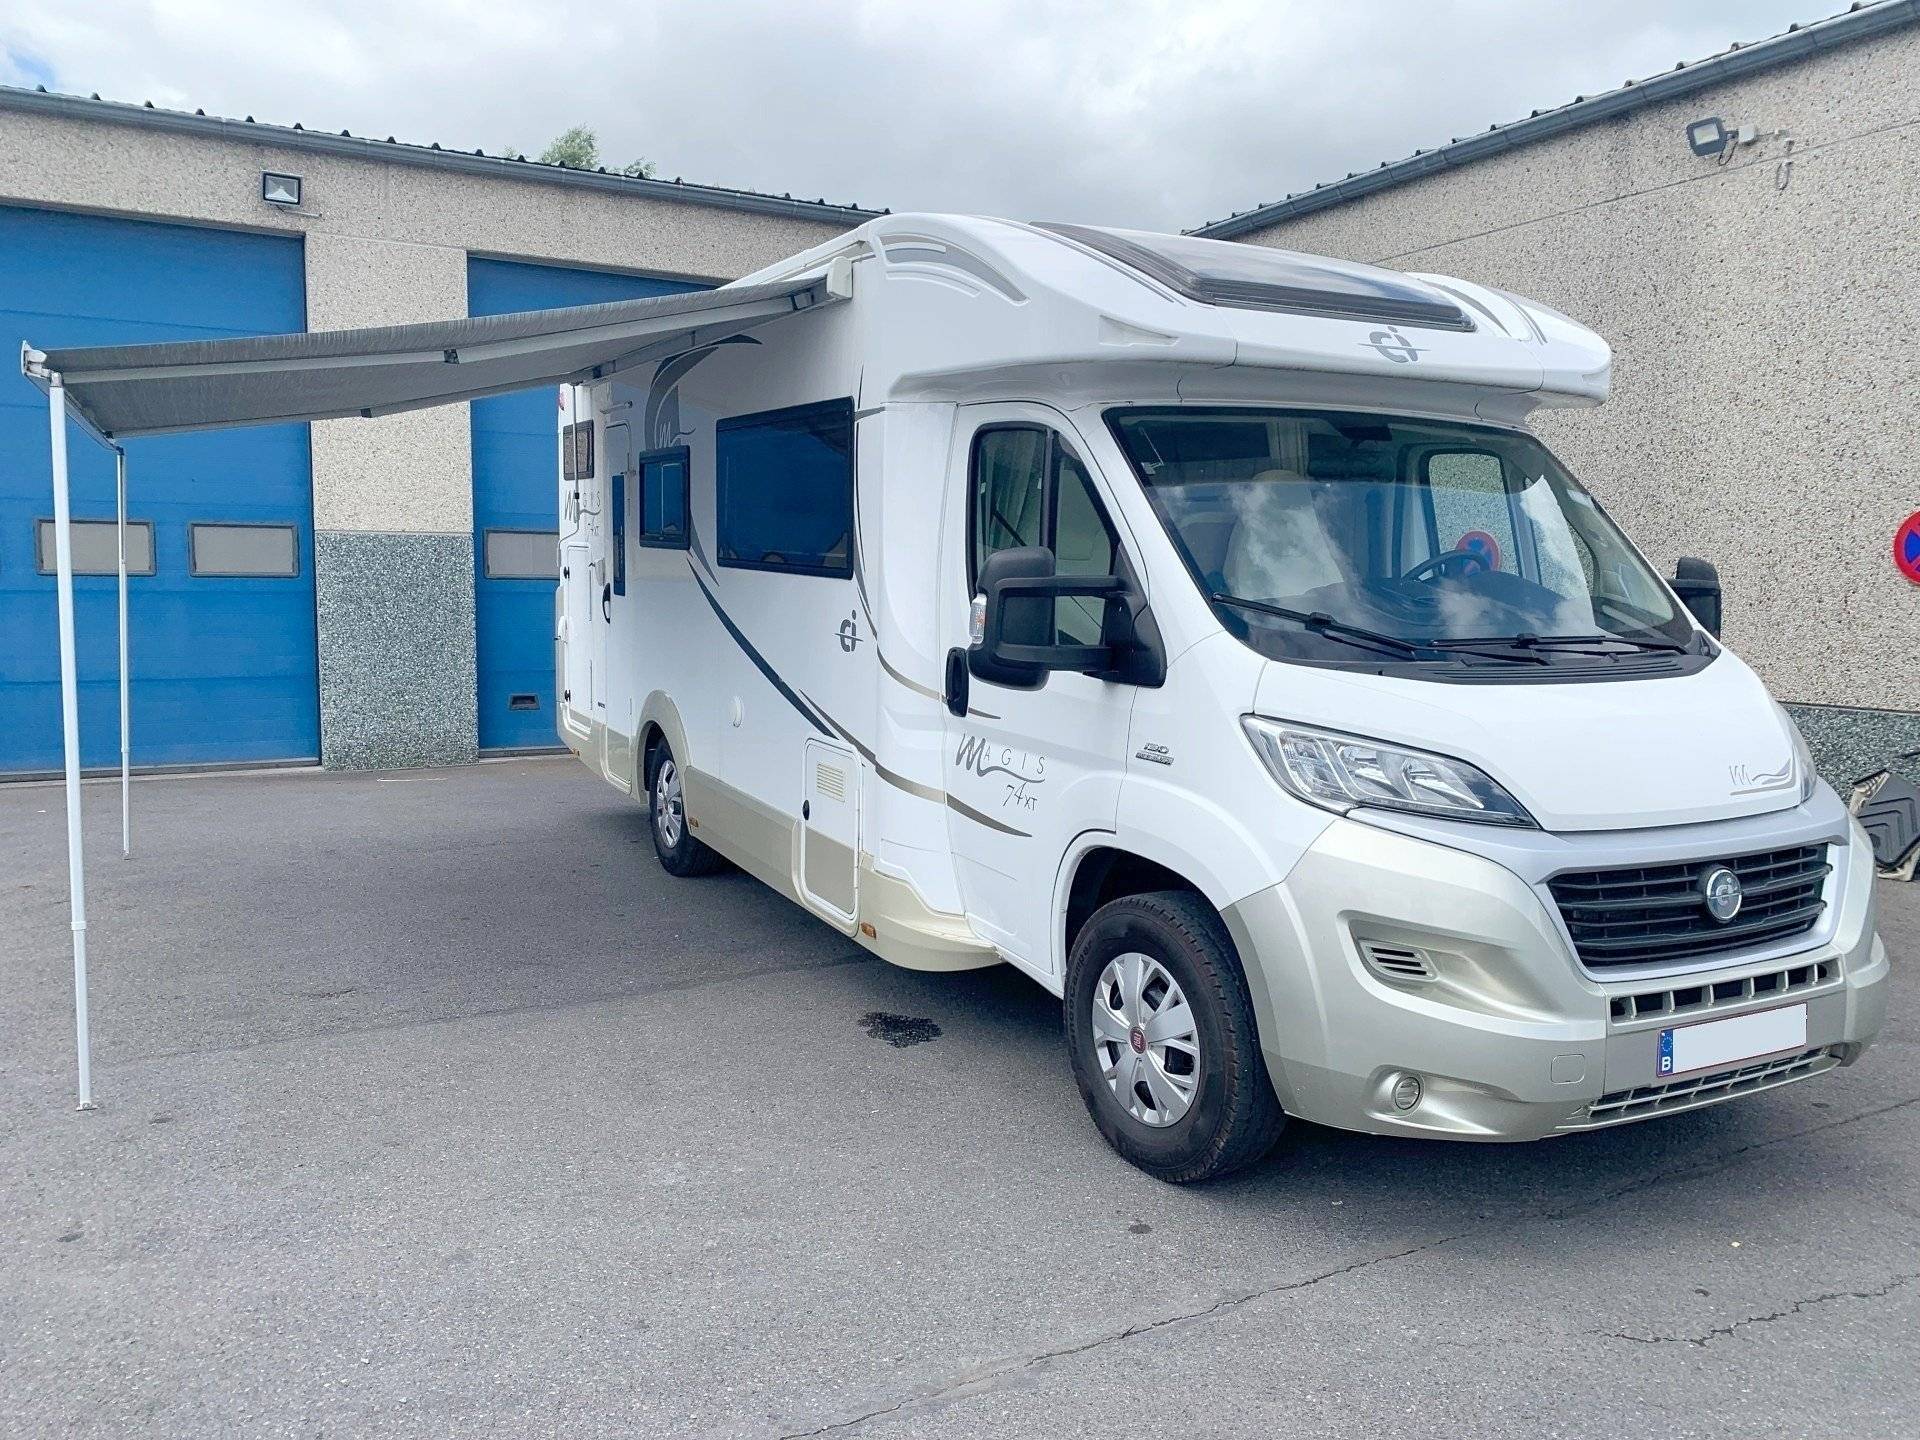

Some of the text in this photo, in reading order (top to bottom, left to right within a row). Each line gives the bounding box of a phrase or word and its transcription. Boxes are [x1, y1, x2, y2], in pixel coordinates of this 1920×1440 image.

[564, 489, 601, 523] MGIS
[955, 732, 1046, 784] MAGIS
[1661, 1056, 1671, 1071] B
